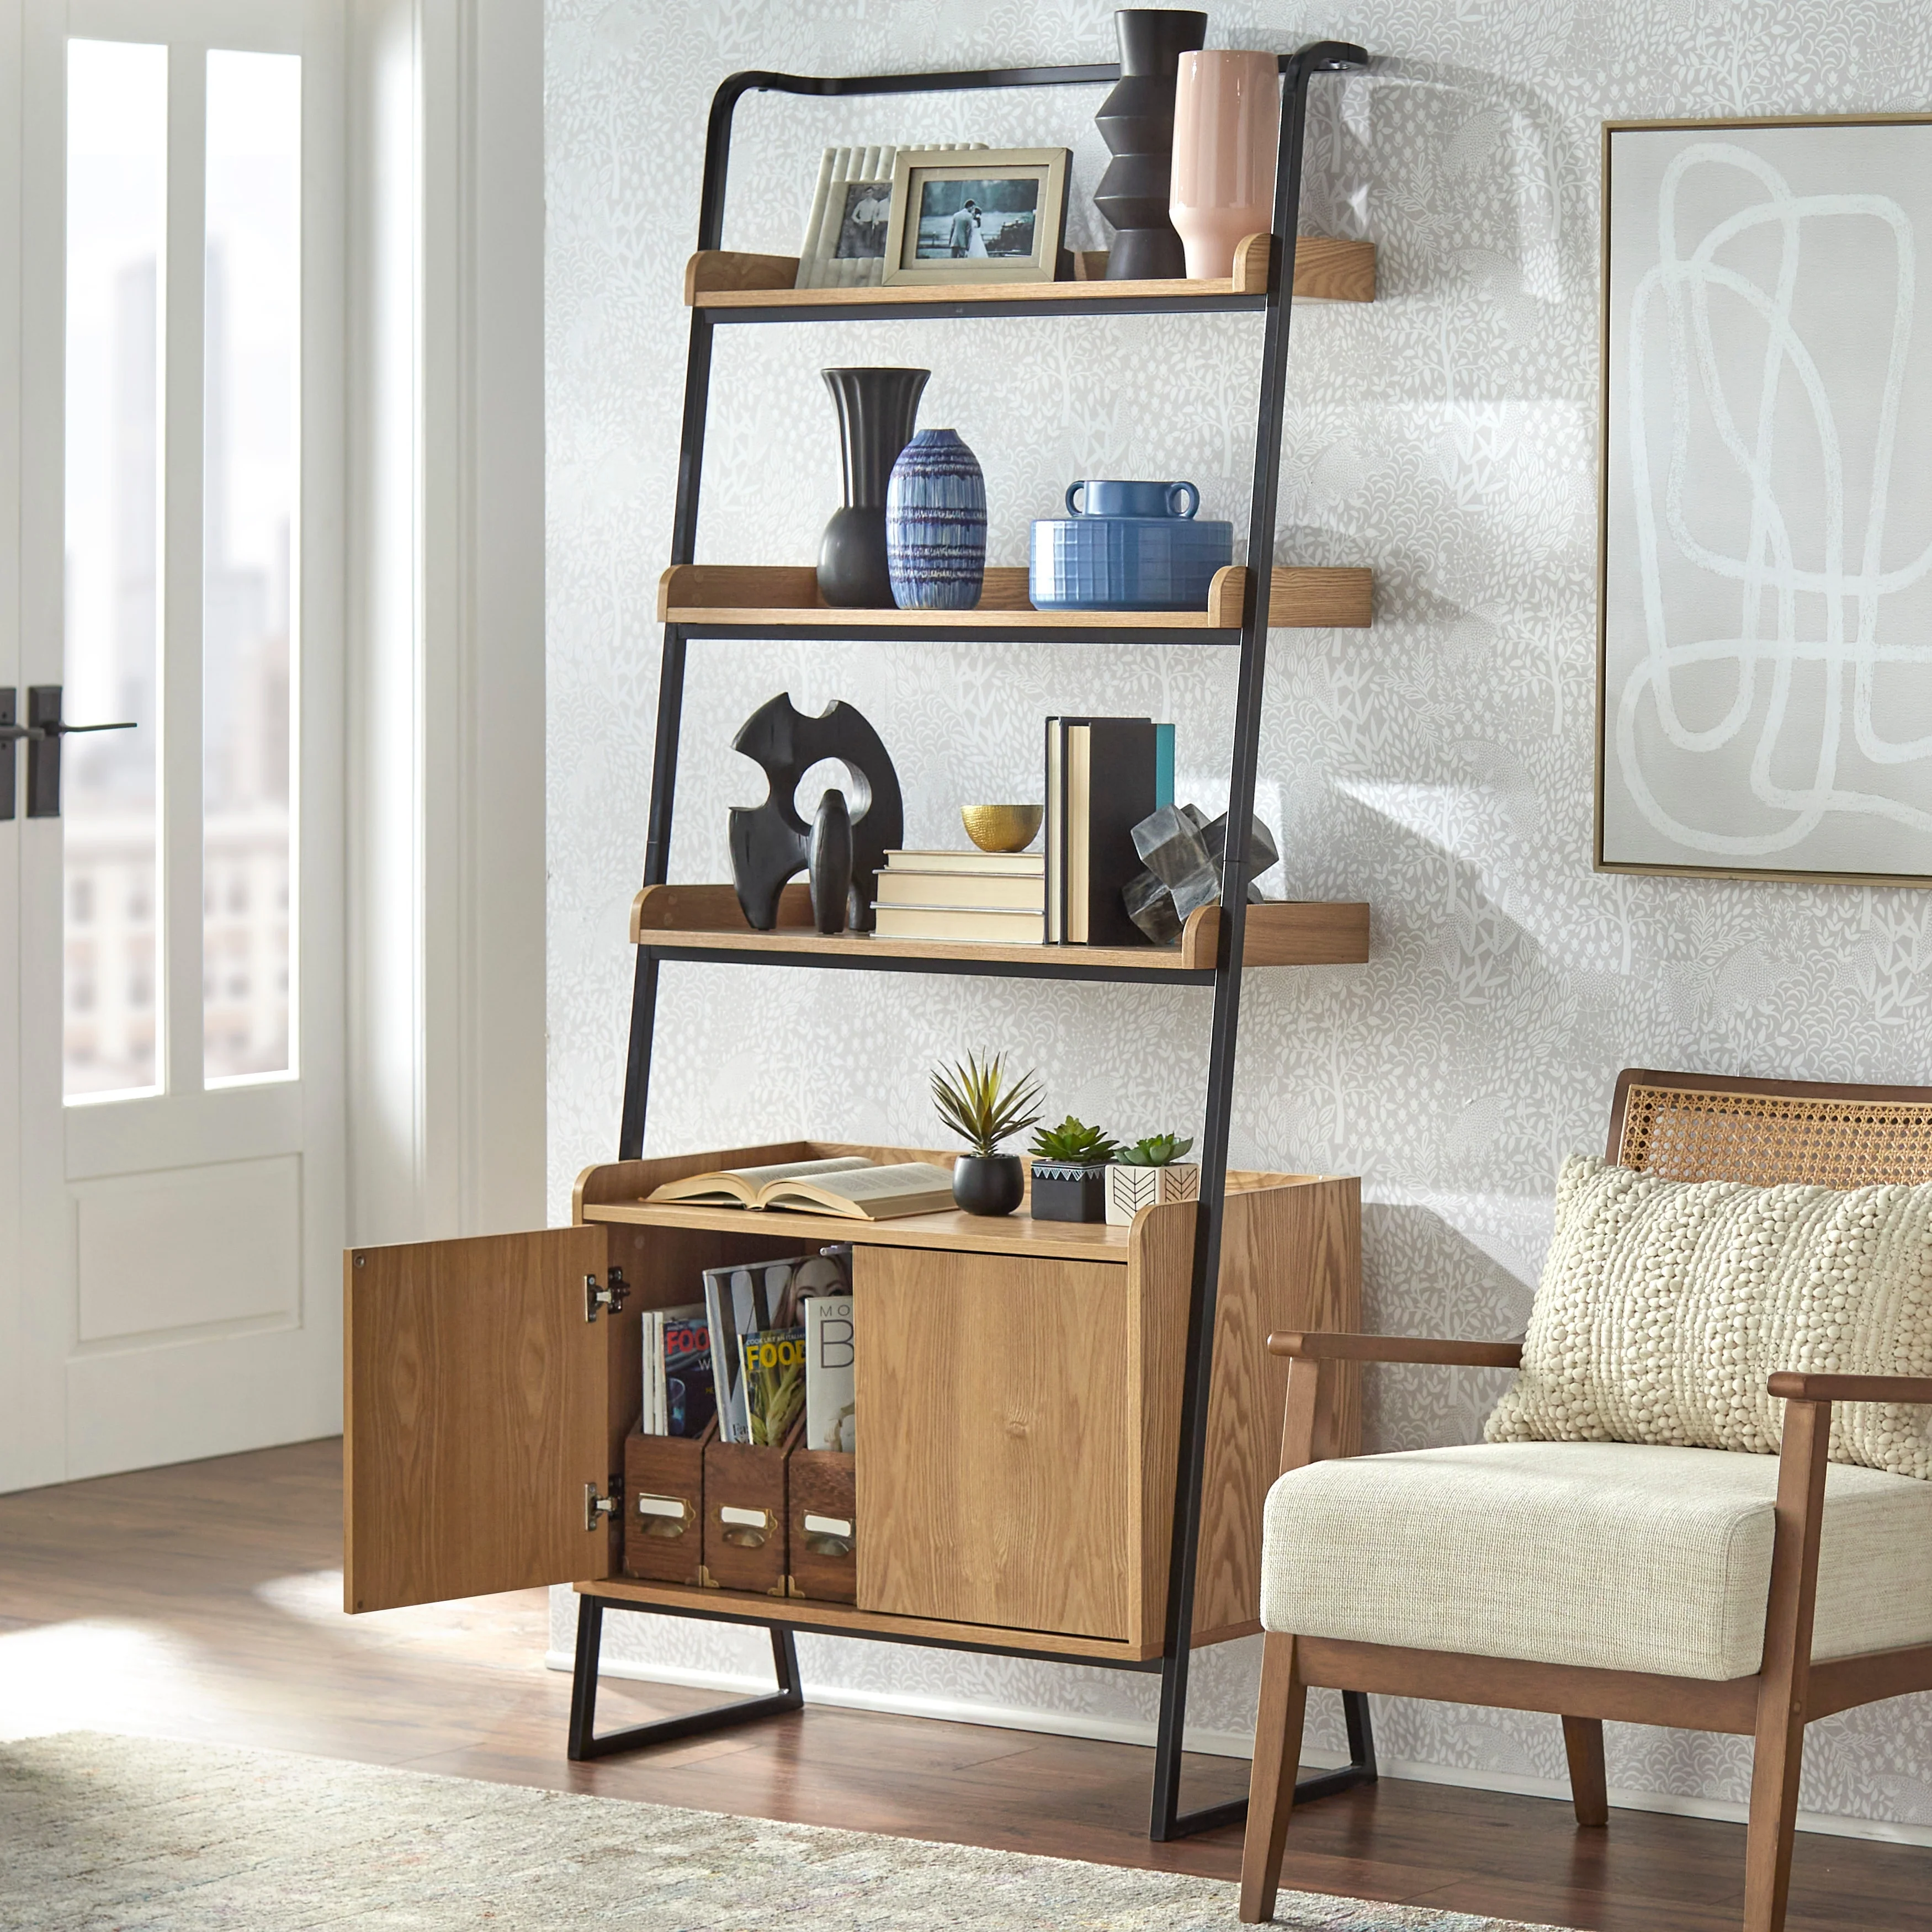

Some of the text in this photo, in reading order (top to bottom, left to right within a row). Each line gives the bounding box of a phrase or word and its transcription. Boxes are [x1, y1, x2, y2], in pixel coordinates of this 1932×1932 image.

[820, 1304, 850, 1317] MO
[745, 1337, 763, 1346] COOK
[820, 1319, 854, 1368] B
